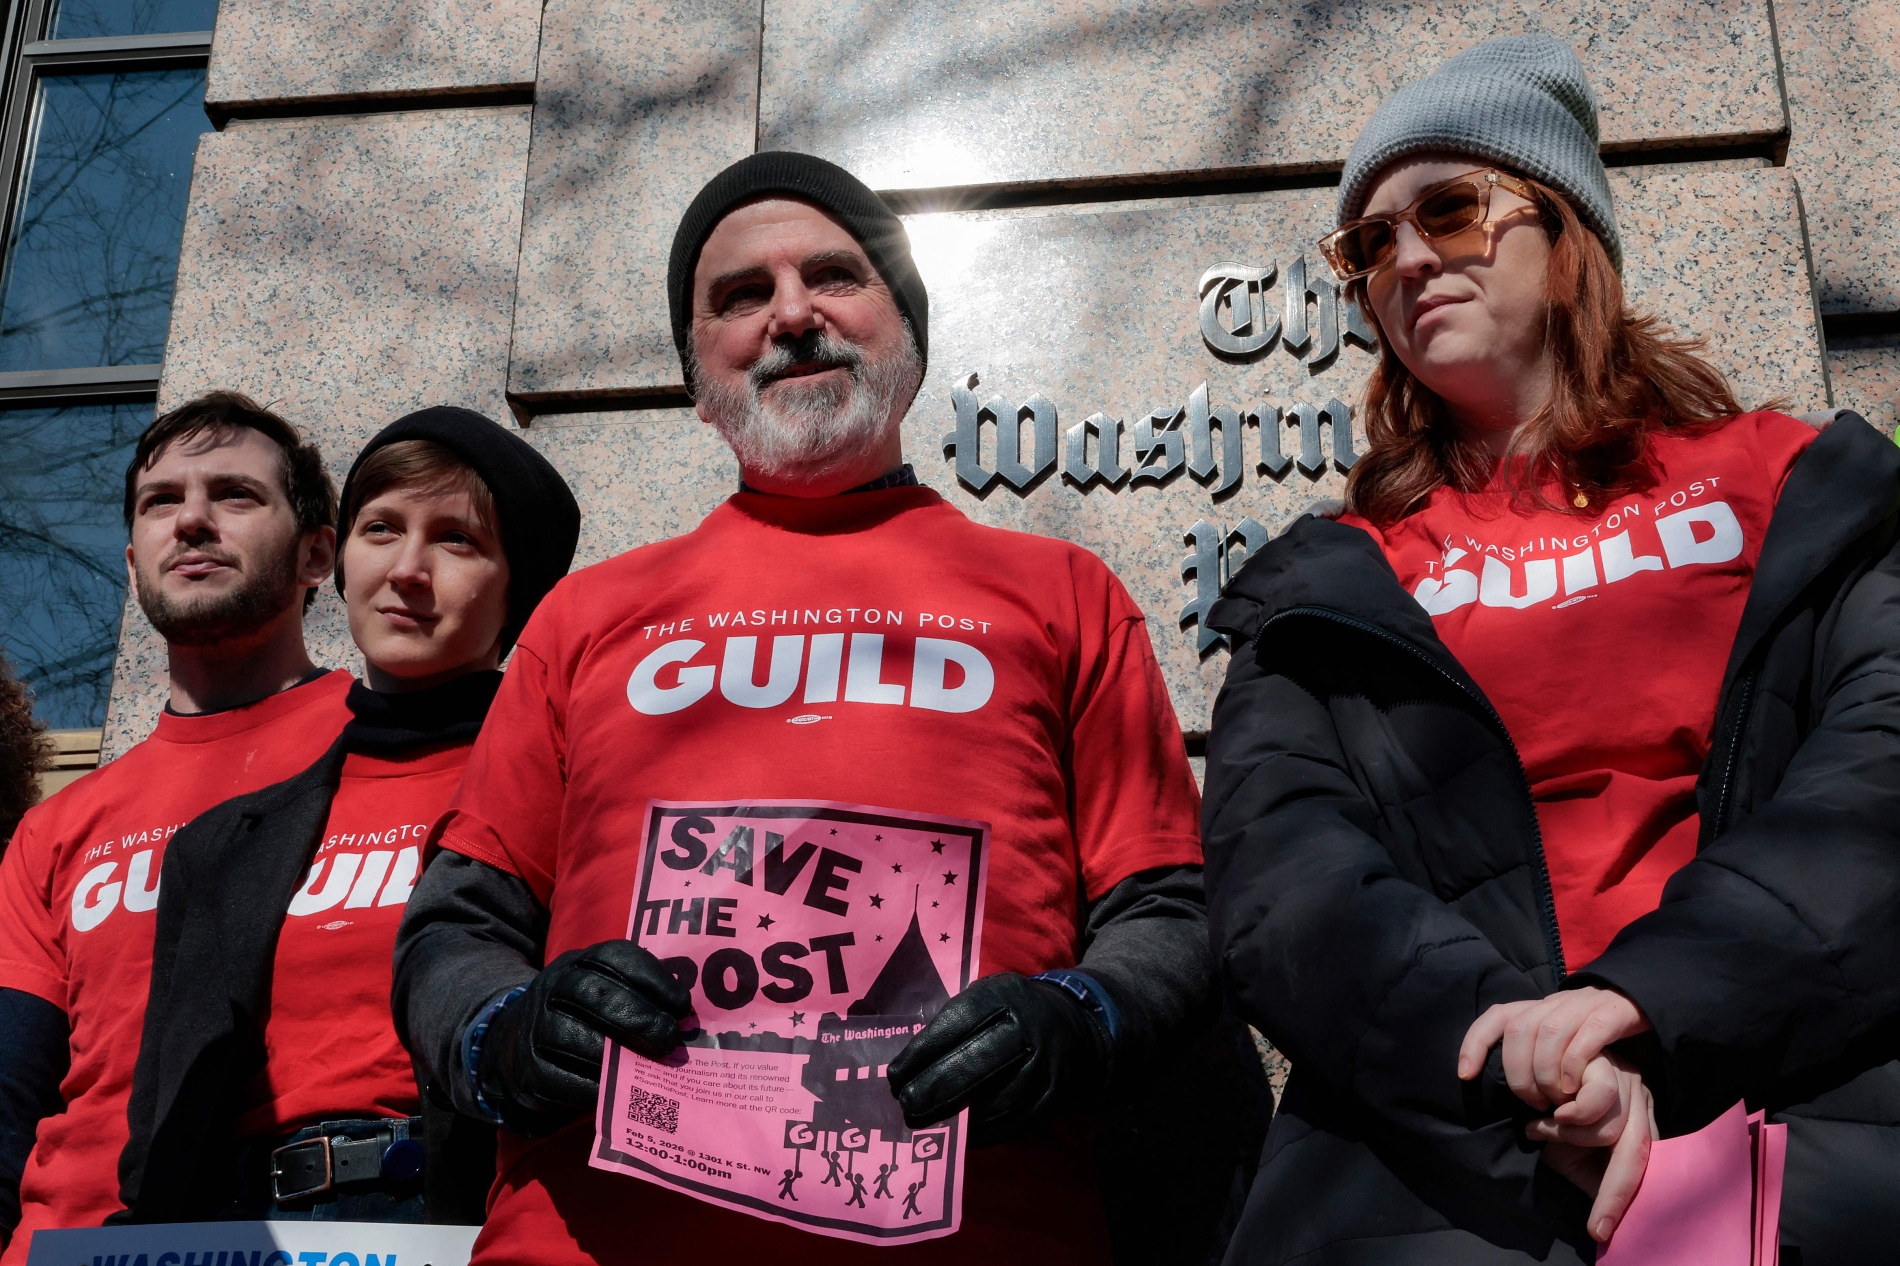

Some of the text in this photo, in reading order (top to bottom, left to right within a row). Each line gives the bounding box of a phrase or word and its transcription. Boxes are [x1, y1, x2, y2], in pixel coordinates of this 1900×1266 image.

[1199, 254, 1377, 370] Th
[942, 373, 1364, 498] Washin
[1465, 504, 1640, 561] WASHINGTON
[1654, 477, 1720, 516] POST
[1413, 501, 1744, 616] GUILD
[643, 608, 992, 640] THE WASHINGTON POST
[626, 632, 995, 716] GUILD
[84, 822, 186, 865] THE WASH
[316, 824, 427, 856] ASHINGTO
[287, 846, 419, 916] UIL
[660, 816, 863, 917] SAVE
[71, 847, 164, 932] GU
[644, 897, 738, 938] THE
[821, 1032, 841, 1044] The
[844, 1026, 909, 1041] Washington
[635, 1061, 652, 1070] past
[662, 1070, 678, 1079] and
[686, 1077, 701, 1085] you
[702, 1080, 721, 1088] care
[722, 1081, 746, 1090] about
[748, 1083, 759, 1091] its
[760, 1084, 785, 1093] future
[675, 1066, 718, 1077] journalism
[749, 1074, 790, 1082] renowned
[694, 1059, 709, 1067] The
[711, 1060, 731, 1069] Post.
[740, 1063, 755, 1071] you
[757, 1063, 779, 1071] value
[647, 1072, 661, 1080] ask
[662, 1078, 678, 1087] that
[680, 1084, 694, 1092] you
[695, 1087, 711, 1095] join
[749, 1094, 764, 1102] call
[691, 1094, 714, 1105] Learn
[716, 1100, 737, 1108] more
[749, 1104, 763, 1112] the
[764, 1105, 777, 1113] QR
[625, 1137, 732, 1179] 12:00-1:00pm
[626, 1127, 644, 1140] Feb
[647, 1135, 656, 1145] 5,
[659, 1140, 685, 1152] 2026
[698, 1152, 722, 1165] 1301
[736, 1162, 751, 1171] St.
[753, 1165, 771, 1176] NW
